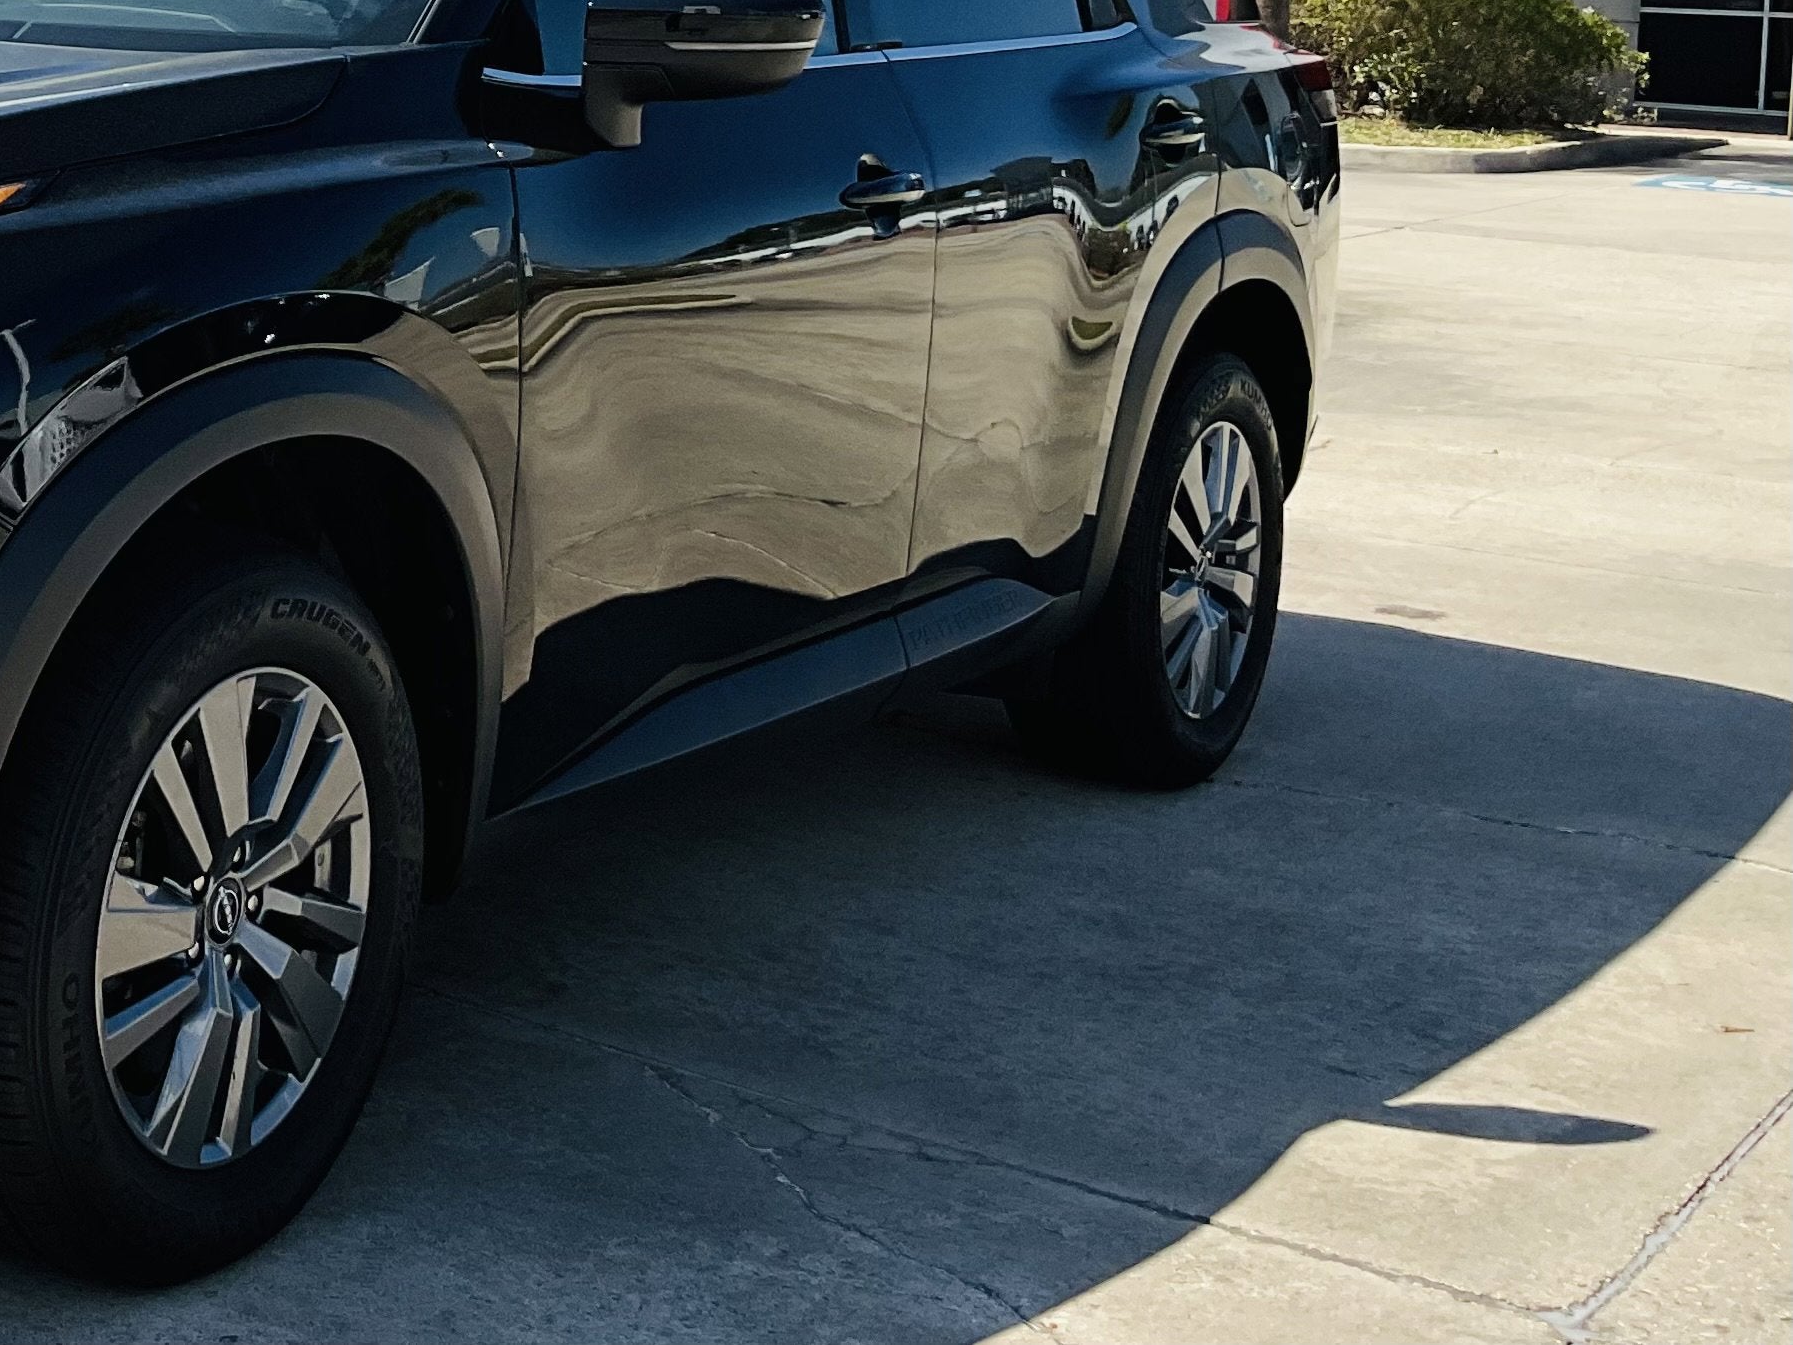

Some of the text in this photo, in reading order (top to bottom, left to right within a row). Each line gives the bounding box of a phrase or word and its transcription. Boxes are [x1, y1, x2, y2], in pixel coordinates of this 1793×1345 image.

[1240, 379, 1273, 429] KUMHO
[270, 598, 371, 656] CRUGEN
[908, 589, 1023, 651] PATHFINDER
